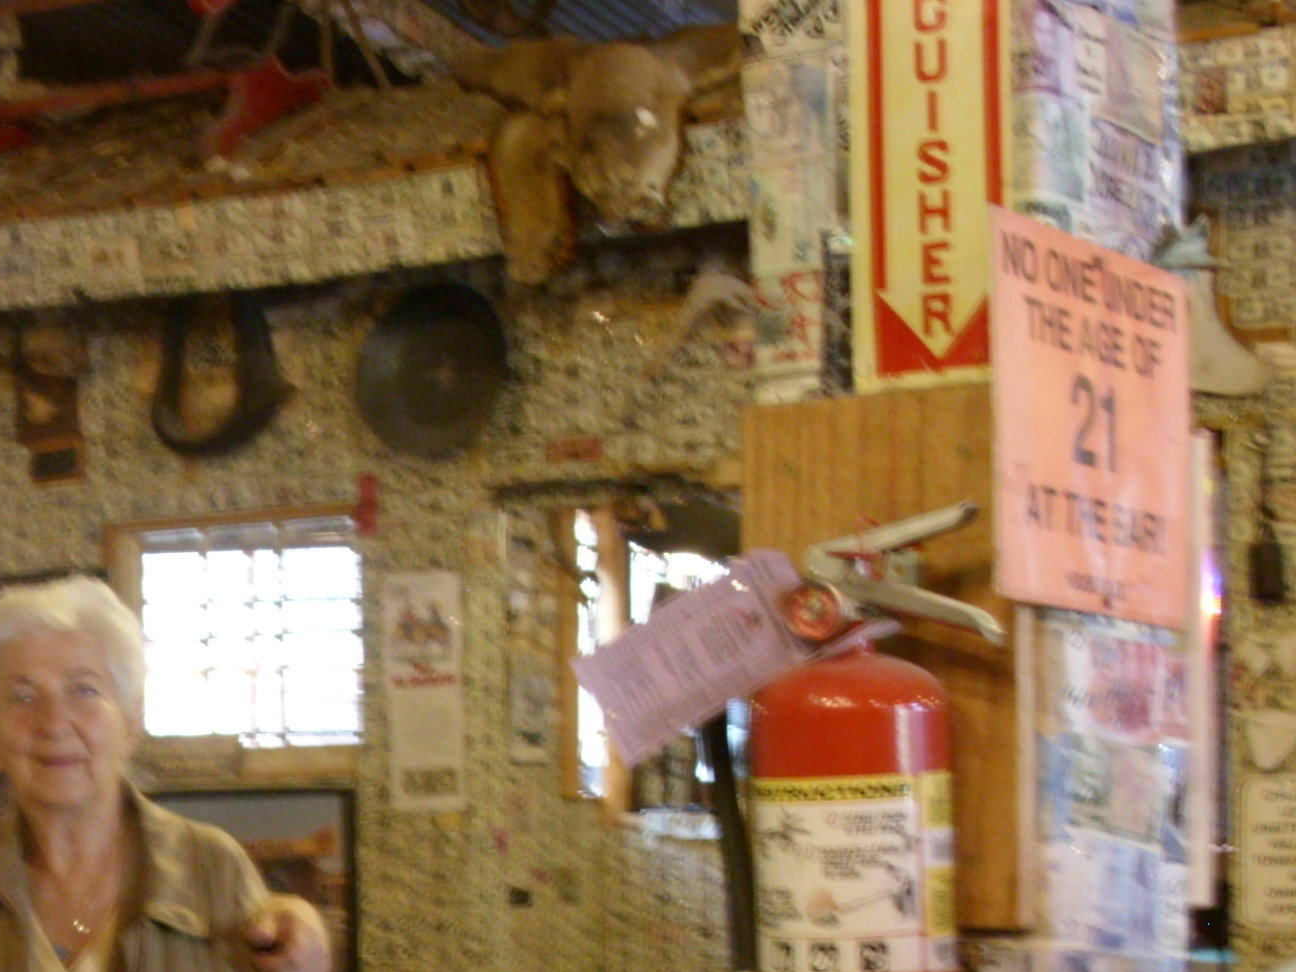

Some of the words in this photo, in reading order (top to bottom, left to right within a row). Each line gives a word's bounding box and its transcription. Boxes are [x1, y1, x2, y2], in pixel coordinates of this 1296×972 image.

[1001, 229, 1038, 284] NO
[1045, 248, 1096, 305] ONE
[1102, 269, 1177, 334] UNDER
[1023, 295, 1072, 353] THE
[1080, 314, 1127, 370] AGE
[1131, 333, 1162, 379] OF
[1070, 372, 1117, 473] 21
[1026, 480, 1057, 532] AT
[1061, 490, 1108, 543] THE
